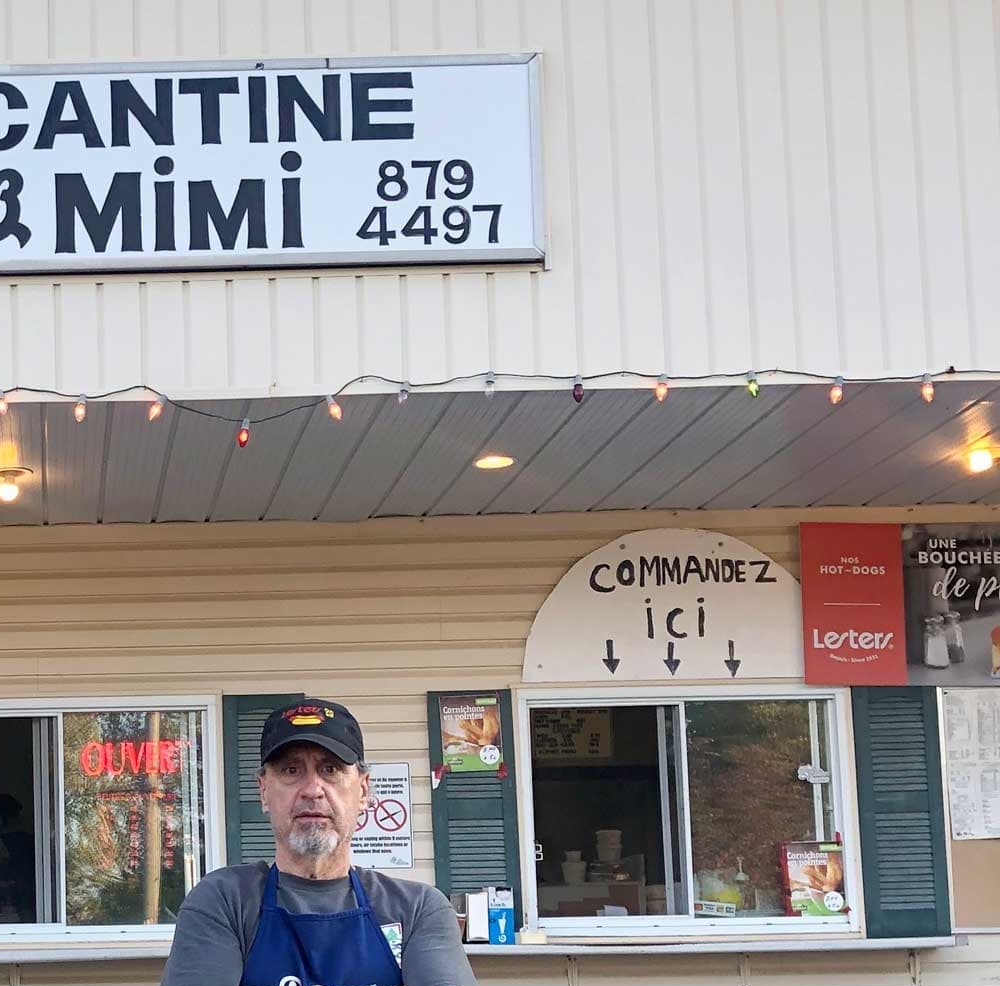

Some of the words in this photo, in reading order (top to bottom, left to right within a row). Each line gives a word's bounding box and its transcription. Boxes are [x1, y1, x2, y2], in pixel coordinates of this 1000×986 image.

[376, 159, 474, 201] 879
[356, 204, 503, 246] 4497
[929, 539, 957, 549] UNE
[589, 555, 777, 593] COMMANDEZ
[932, 567, 970, 600] de
[974, 576, 1000, 611] p
[813, 628, 893, 650] Lesters
[443, 705, 485, 714] Cornichons
[787, 851, 828, 860] Cornichons
